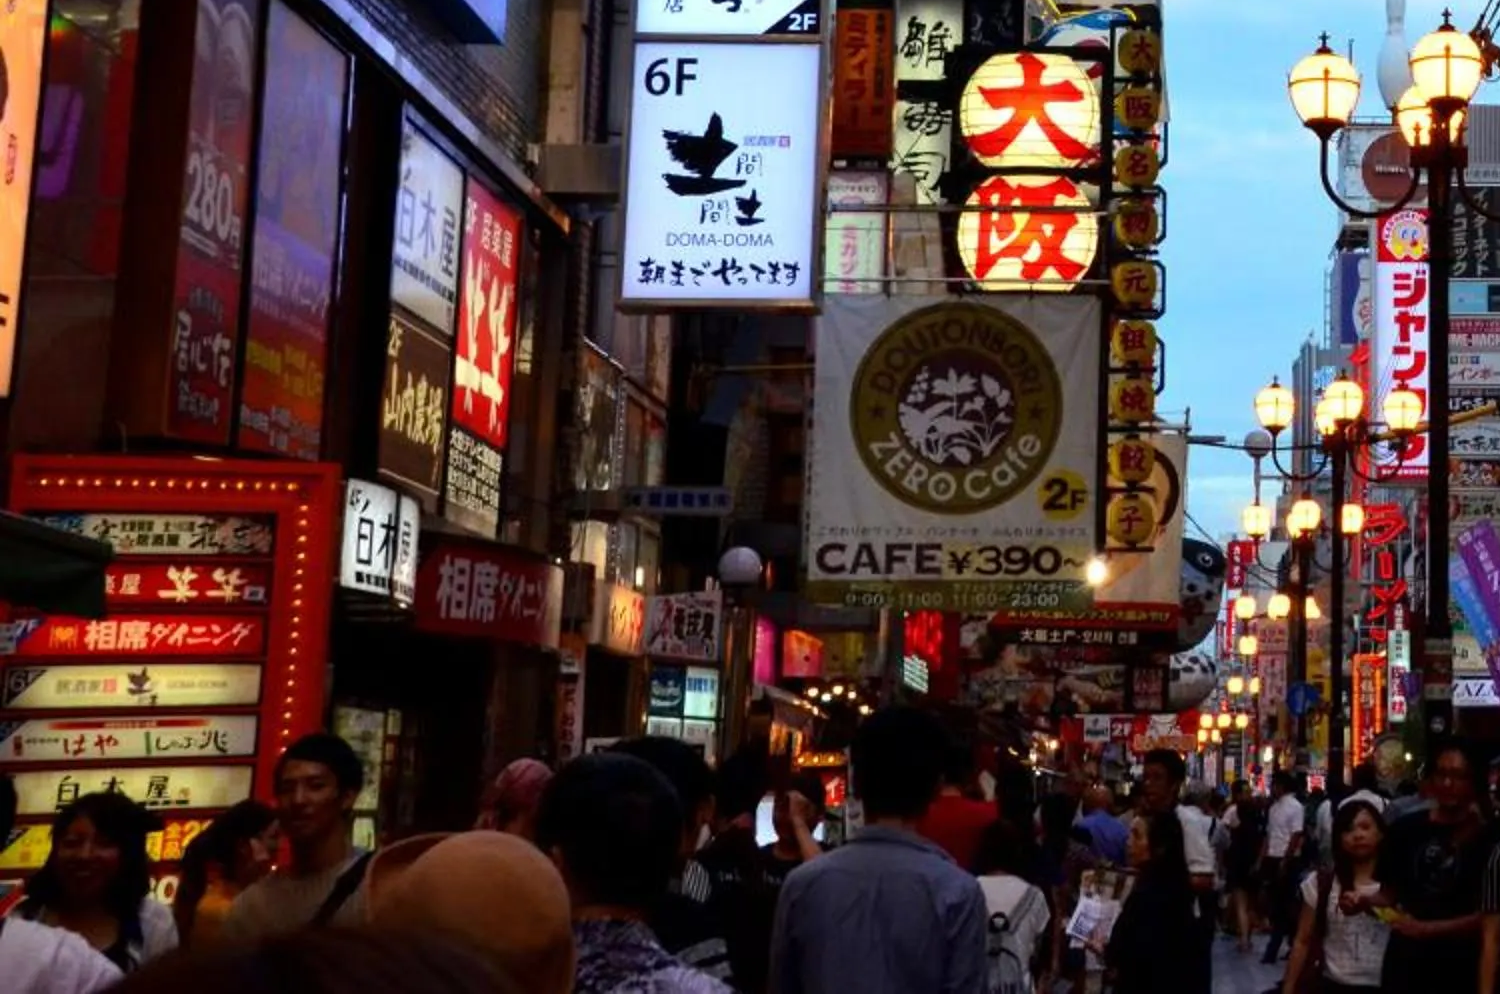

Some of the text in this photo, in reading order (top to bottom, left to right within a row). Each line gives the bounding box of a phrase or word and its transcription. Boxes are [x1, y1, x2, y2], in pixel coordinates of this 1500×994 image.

[788, 13, 817, 31] 2F
[645, 58, 698, 96] 6F
[963, 52, 1099, 282] 大阪
[395, 166, 456, 279] 白木屋
[666, 232, 773, 248] DOMA-DOMA
[638, 256, 800, 286] 朝までやってます
[384, 376, 444, 453] 山内農場
[1042, 478, 1088, 511] 2F
[815, 542, 942, 574] CAFE
[84, 619, 256, 651] 相席ダイニング
